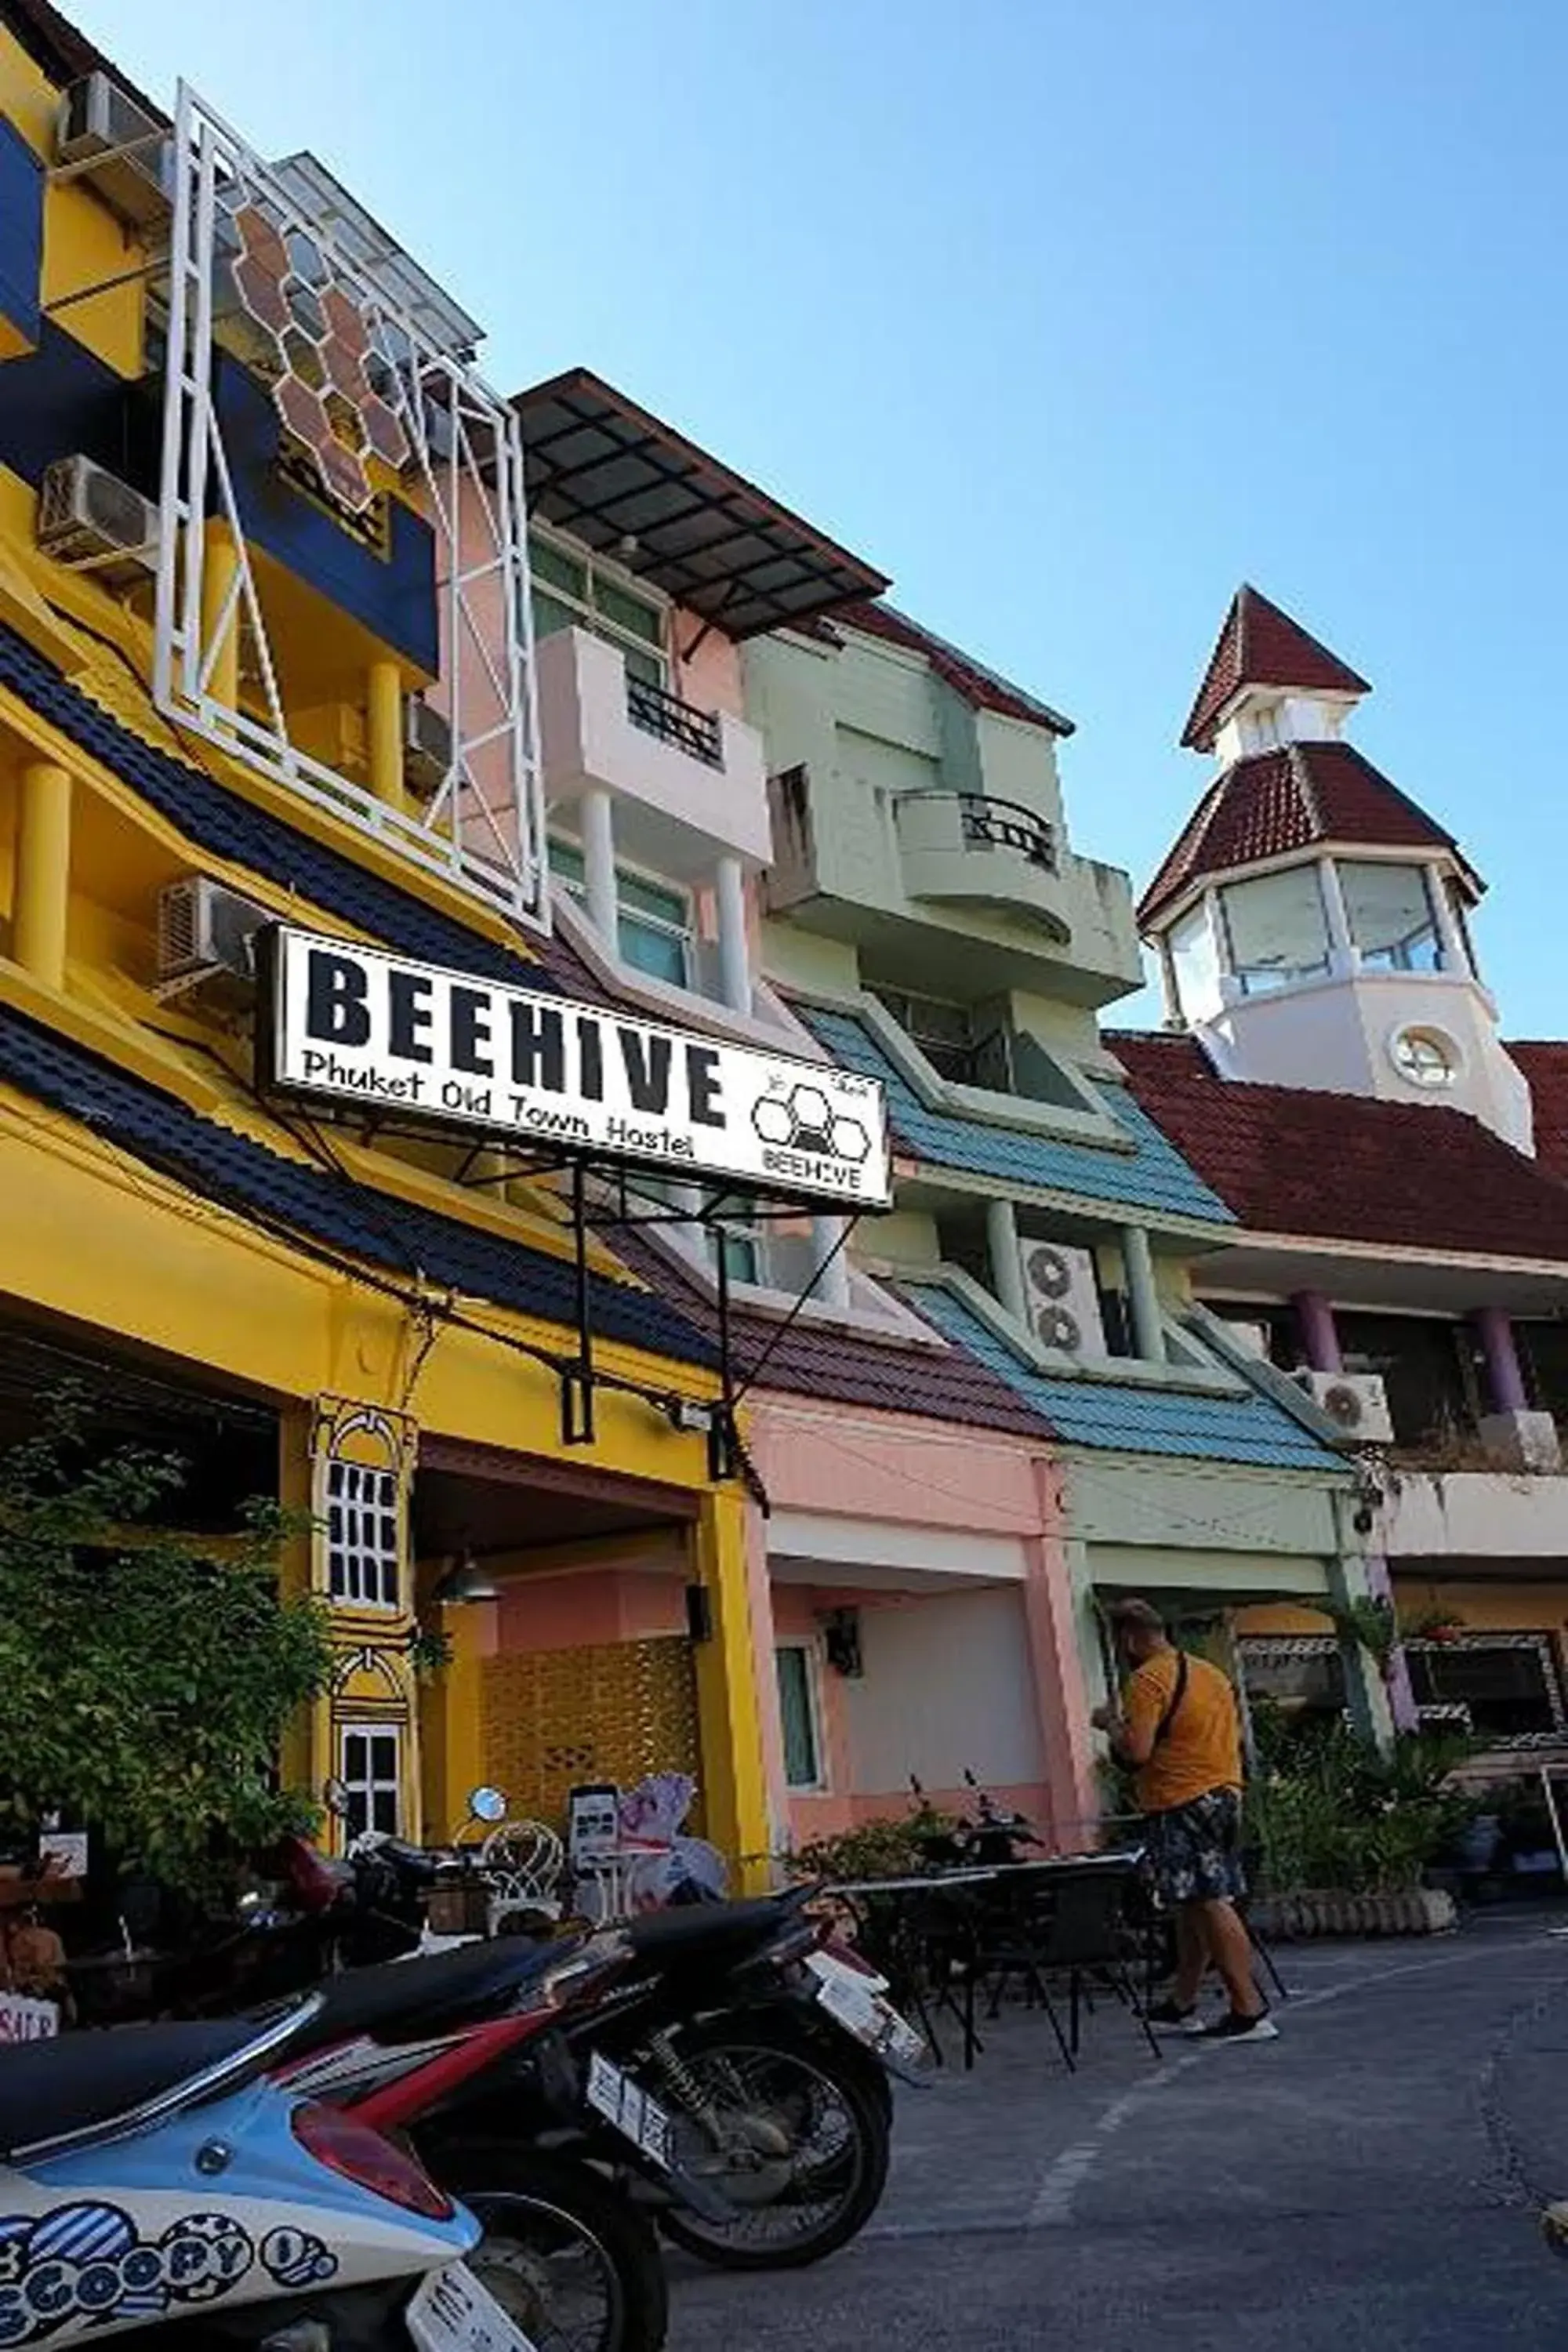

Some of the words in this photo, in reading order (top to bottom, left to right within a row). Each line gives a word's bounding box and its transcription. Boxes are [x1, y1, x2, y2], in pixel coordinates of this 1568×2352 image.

[307, 949, 727, 1129] BEEHIVE
[301, 1049, 426, 1101] Phuket
[441, 1080, 492, 1116] Old
[508, 1093, 590, 1137] Town
[606, 1116, 695, 1159] Hostel
[763, 1148, 861, 1189] BEEHIVE
